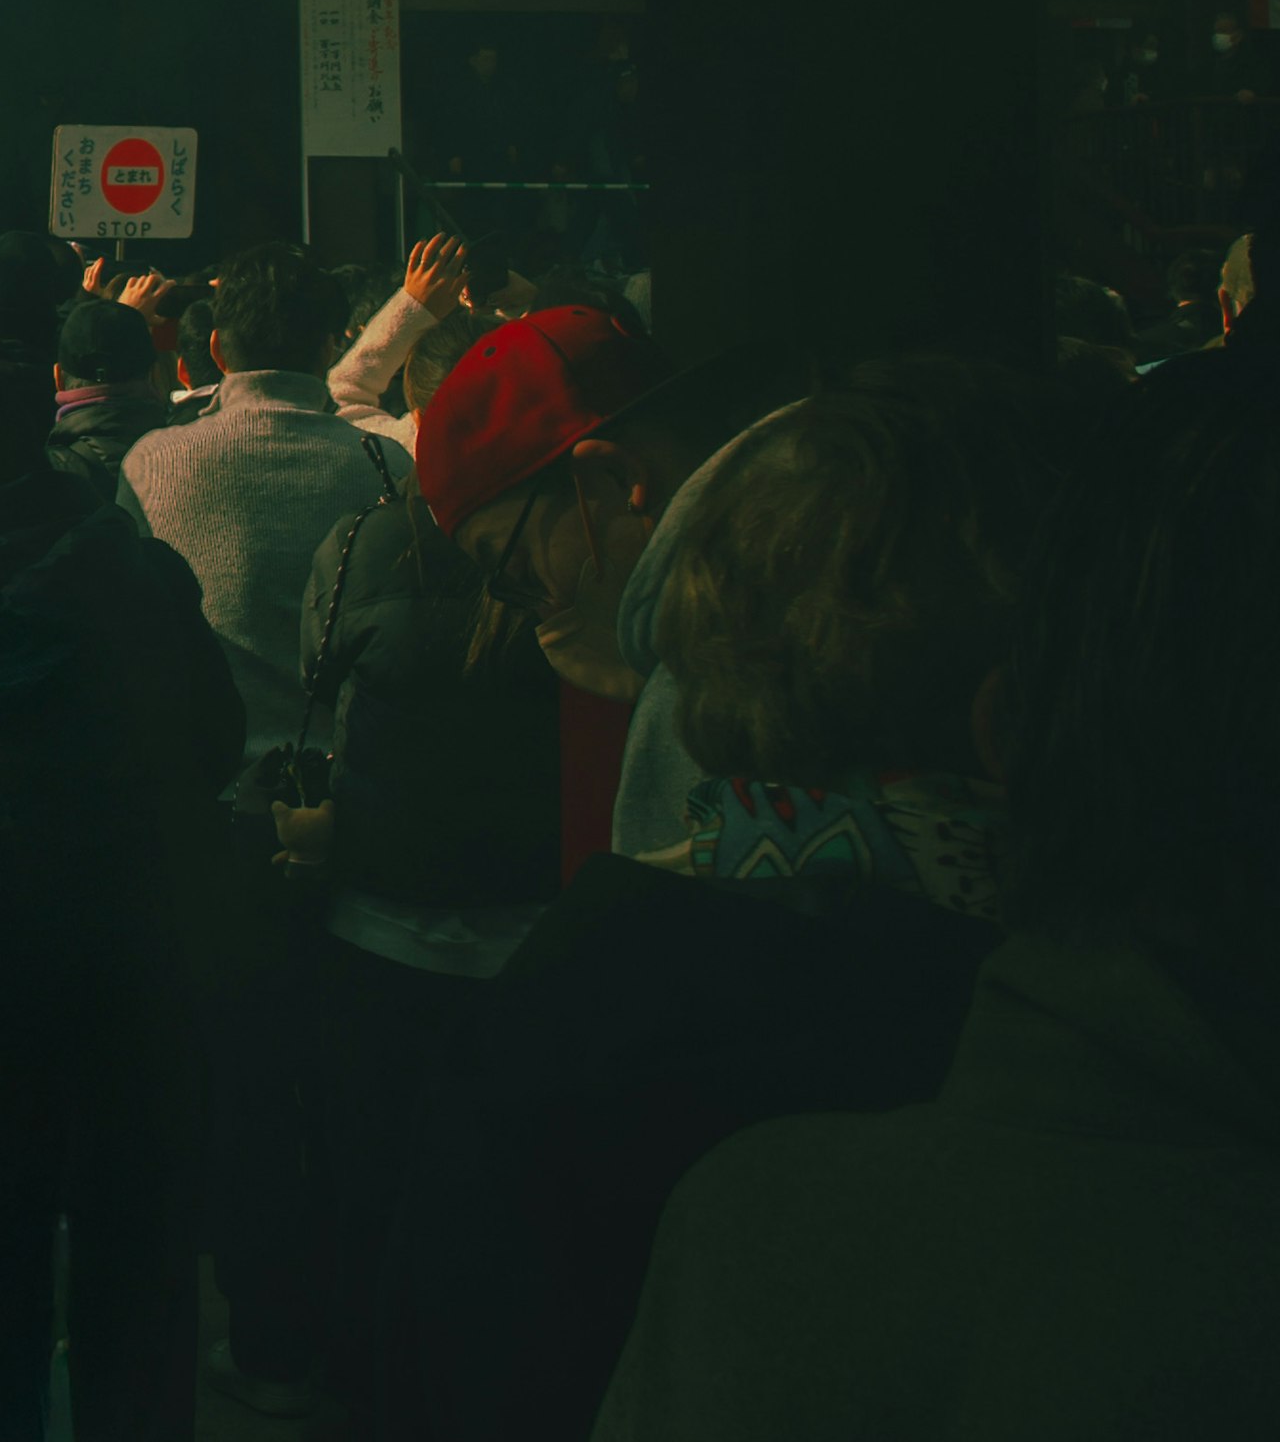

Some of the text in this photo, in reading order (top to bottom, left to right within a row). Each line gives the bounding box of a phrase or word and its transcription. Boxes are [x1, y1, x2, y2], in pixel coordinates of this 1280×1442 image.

[79, 137, 95, 195] おまち
[113, 169, 152, 184] とまれ
[170, 139, 188, 216] しばらく
[97, 221, 152, 237] STOP
